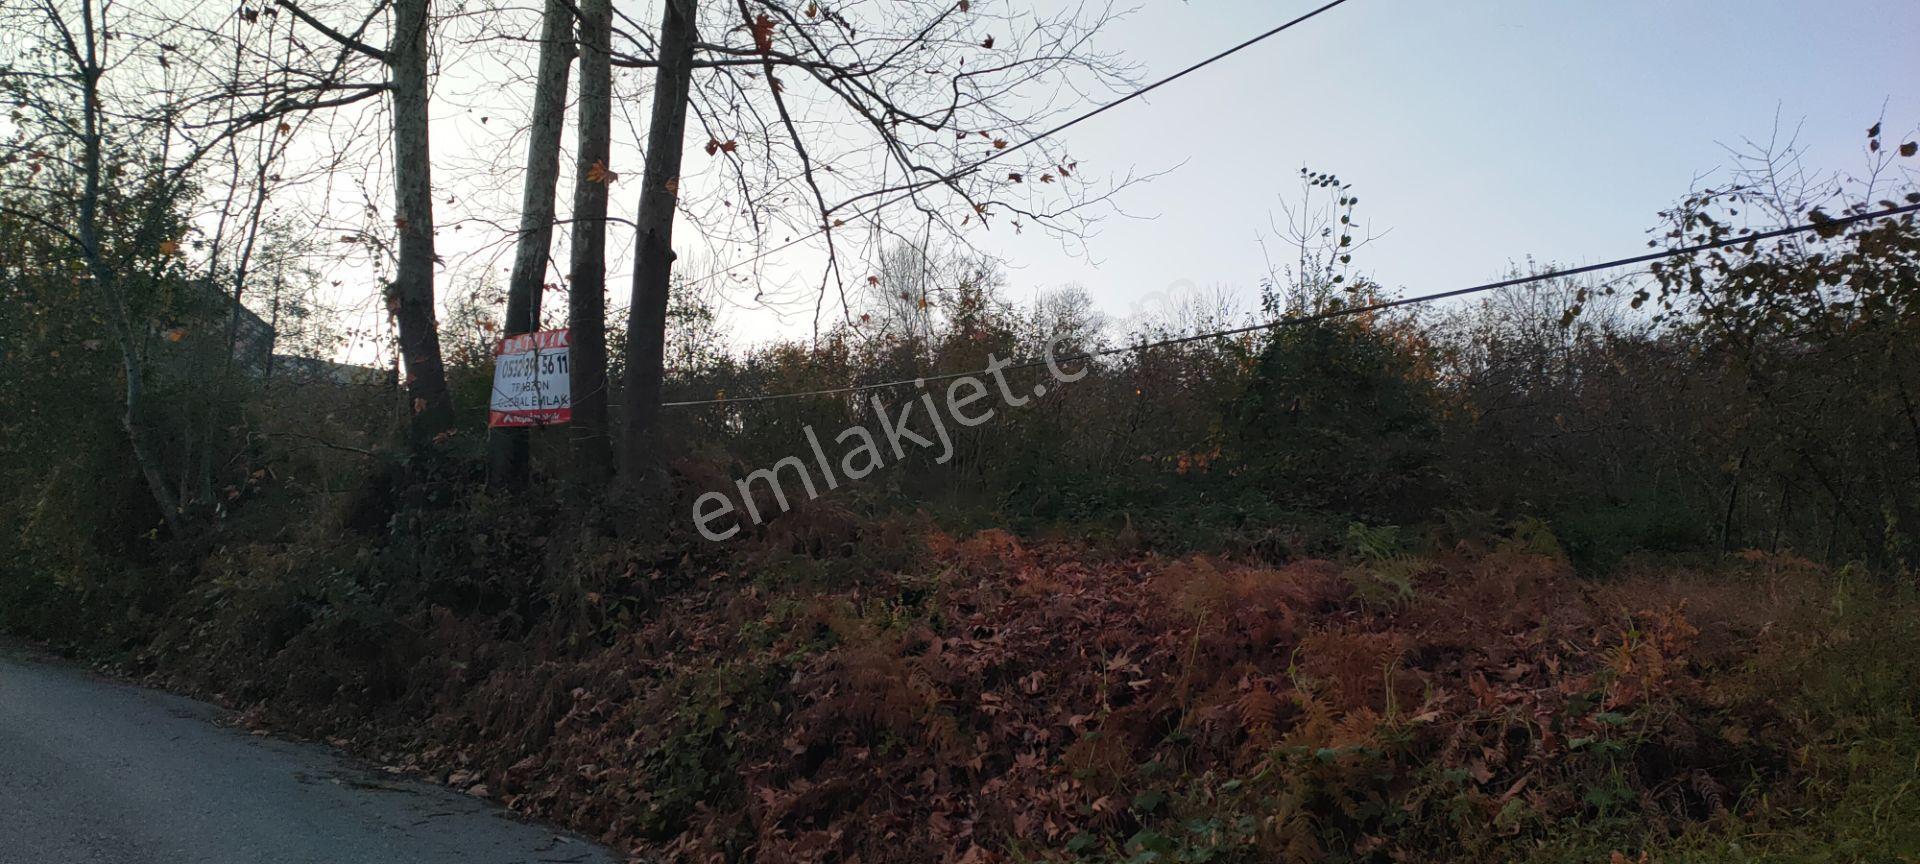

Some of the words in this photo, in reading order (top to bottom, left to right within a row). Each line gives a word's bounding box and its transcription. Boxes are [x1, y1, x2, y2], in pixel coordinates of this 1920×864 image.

[524, 357, 540, 377] 39
[541, 355, 554, 375] 56
[557, 354, 568, 374] 11
[531, 394, 569, 407] EMLAK
